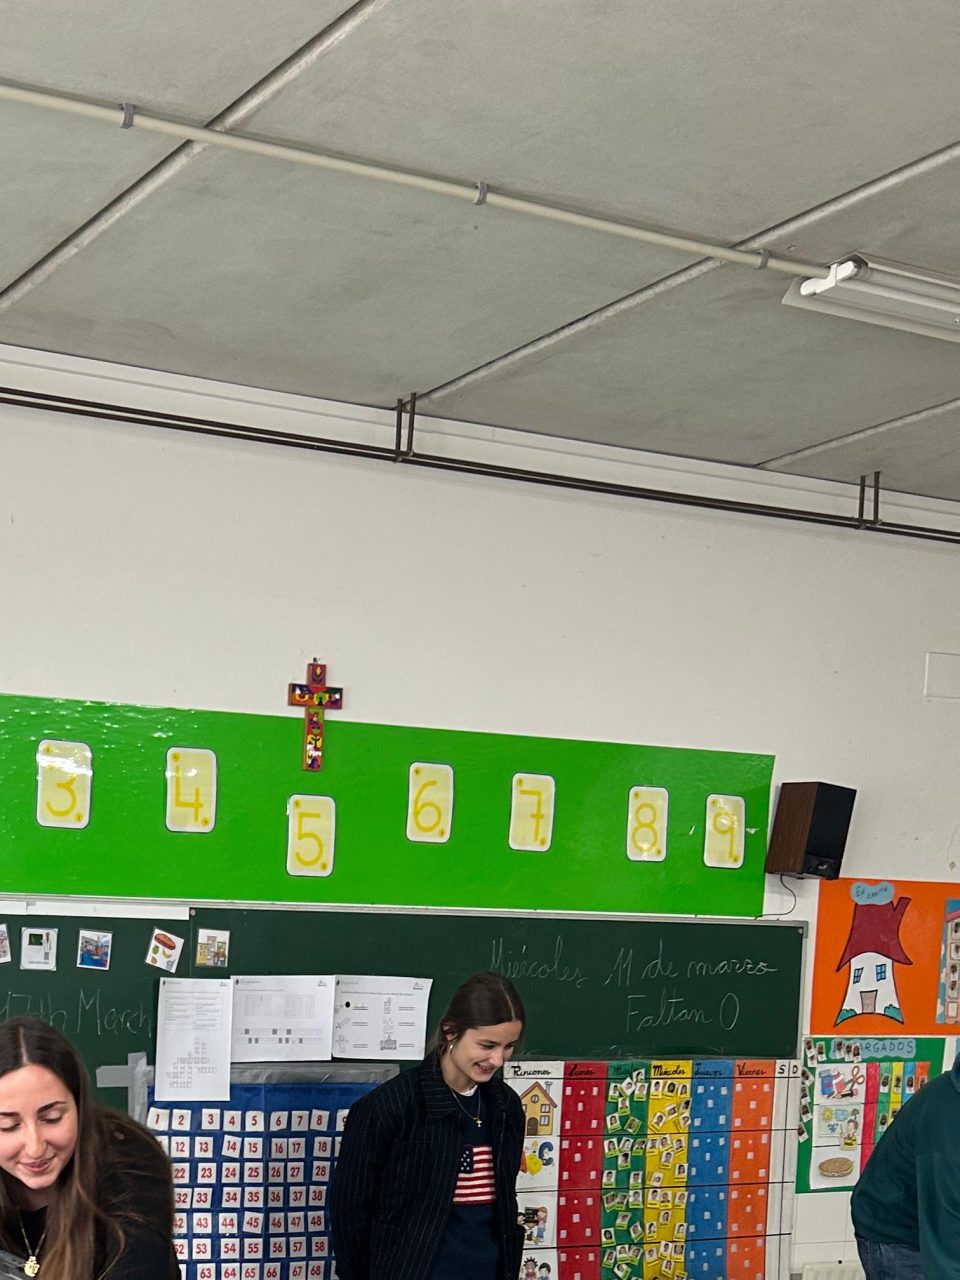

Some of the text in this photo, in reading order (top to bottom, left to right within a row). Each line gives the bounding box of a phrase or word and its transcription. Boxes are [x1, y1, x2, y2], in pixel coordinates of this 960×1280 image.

[45, 764, 77, 817] 3
[174, 765, 204, 822] 4
[295, 812, 323, 866] 5
[414, 781, 442, 833] 6
[520, 789, 545, 841] 7
[632, 803, 658, 852] 8
[713, 811, 736, 860] 9
[490, 935, 778, 988] Miércoles 11 de marzo
[77, 988, 151, 1038] March
[626, 987, 712, 1033] Faltan
[510, 1065, 552, 1077] Rincones
[777, 1064, 786, 1075] S
[792, 1065, 799, 1075] D
[155, 1112, 325, 1128] 1 2 3 4 5 6 7 8
[175, 1141, 328, 1154] 12 13 14 15 16 17 18
[174, 1165, 327, 1180] 22 23 24 25 26 27 28
[175, 1189, 323, 1205] 32 33 34 35 36 37 38
[196, 1216, 322, 1229] 43 44 45 46 47 48
[195, 1240, 325, 1256] 53 54 55 56 57 58
[200, 1264, 321, 1280] 63 64 65 66 67 68
